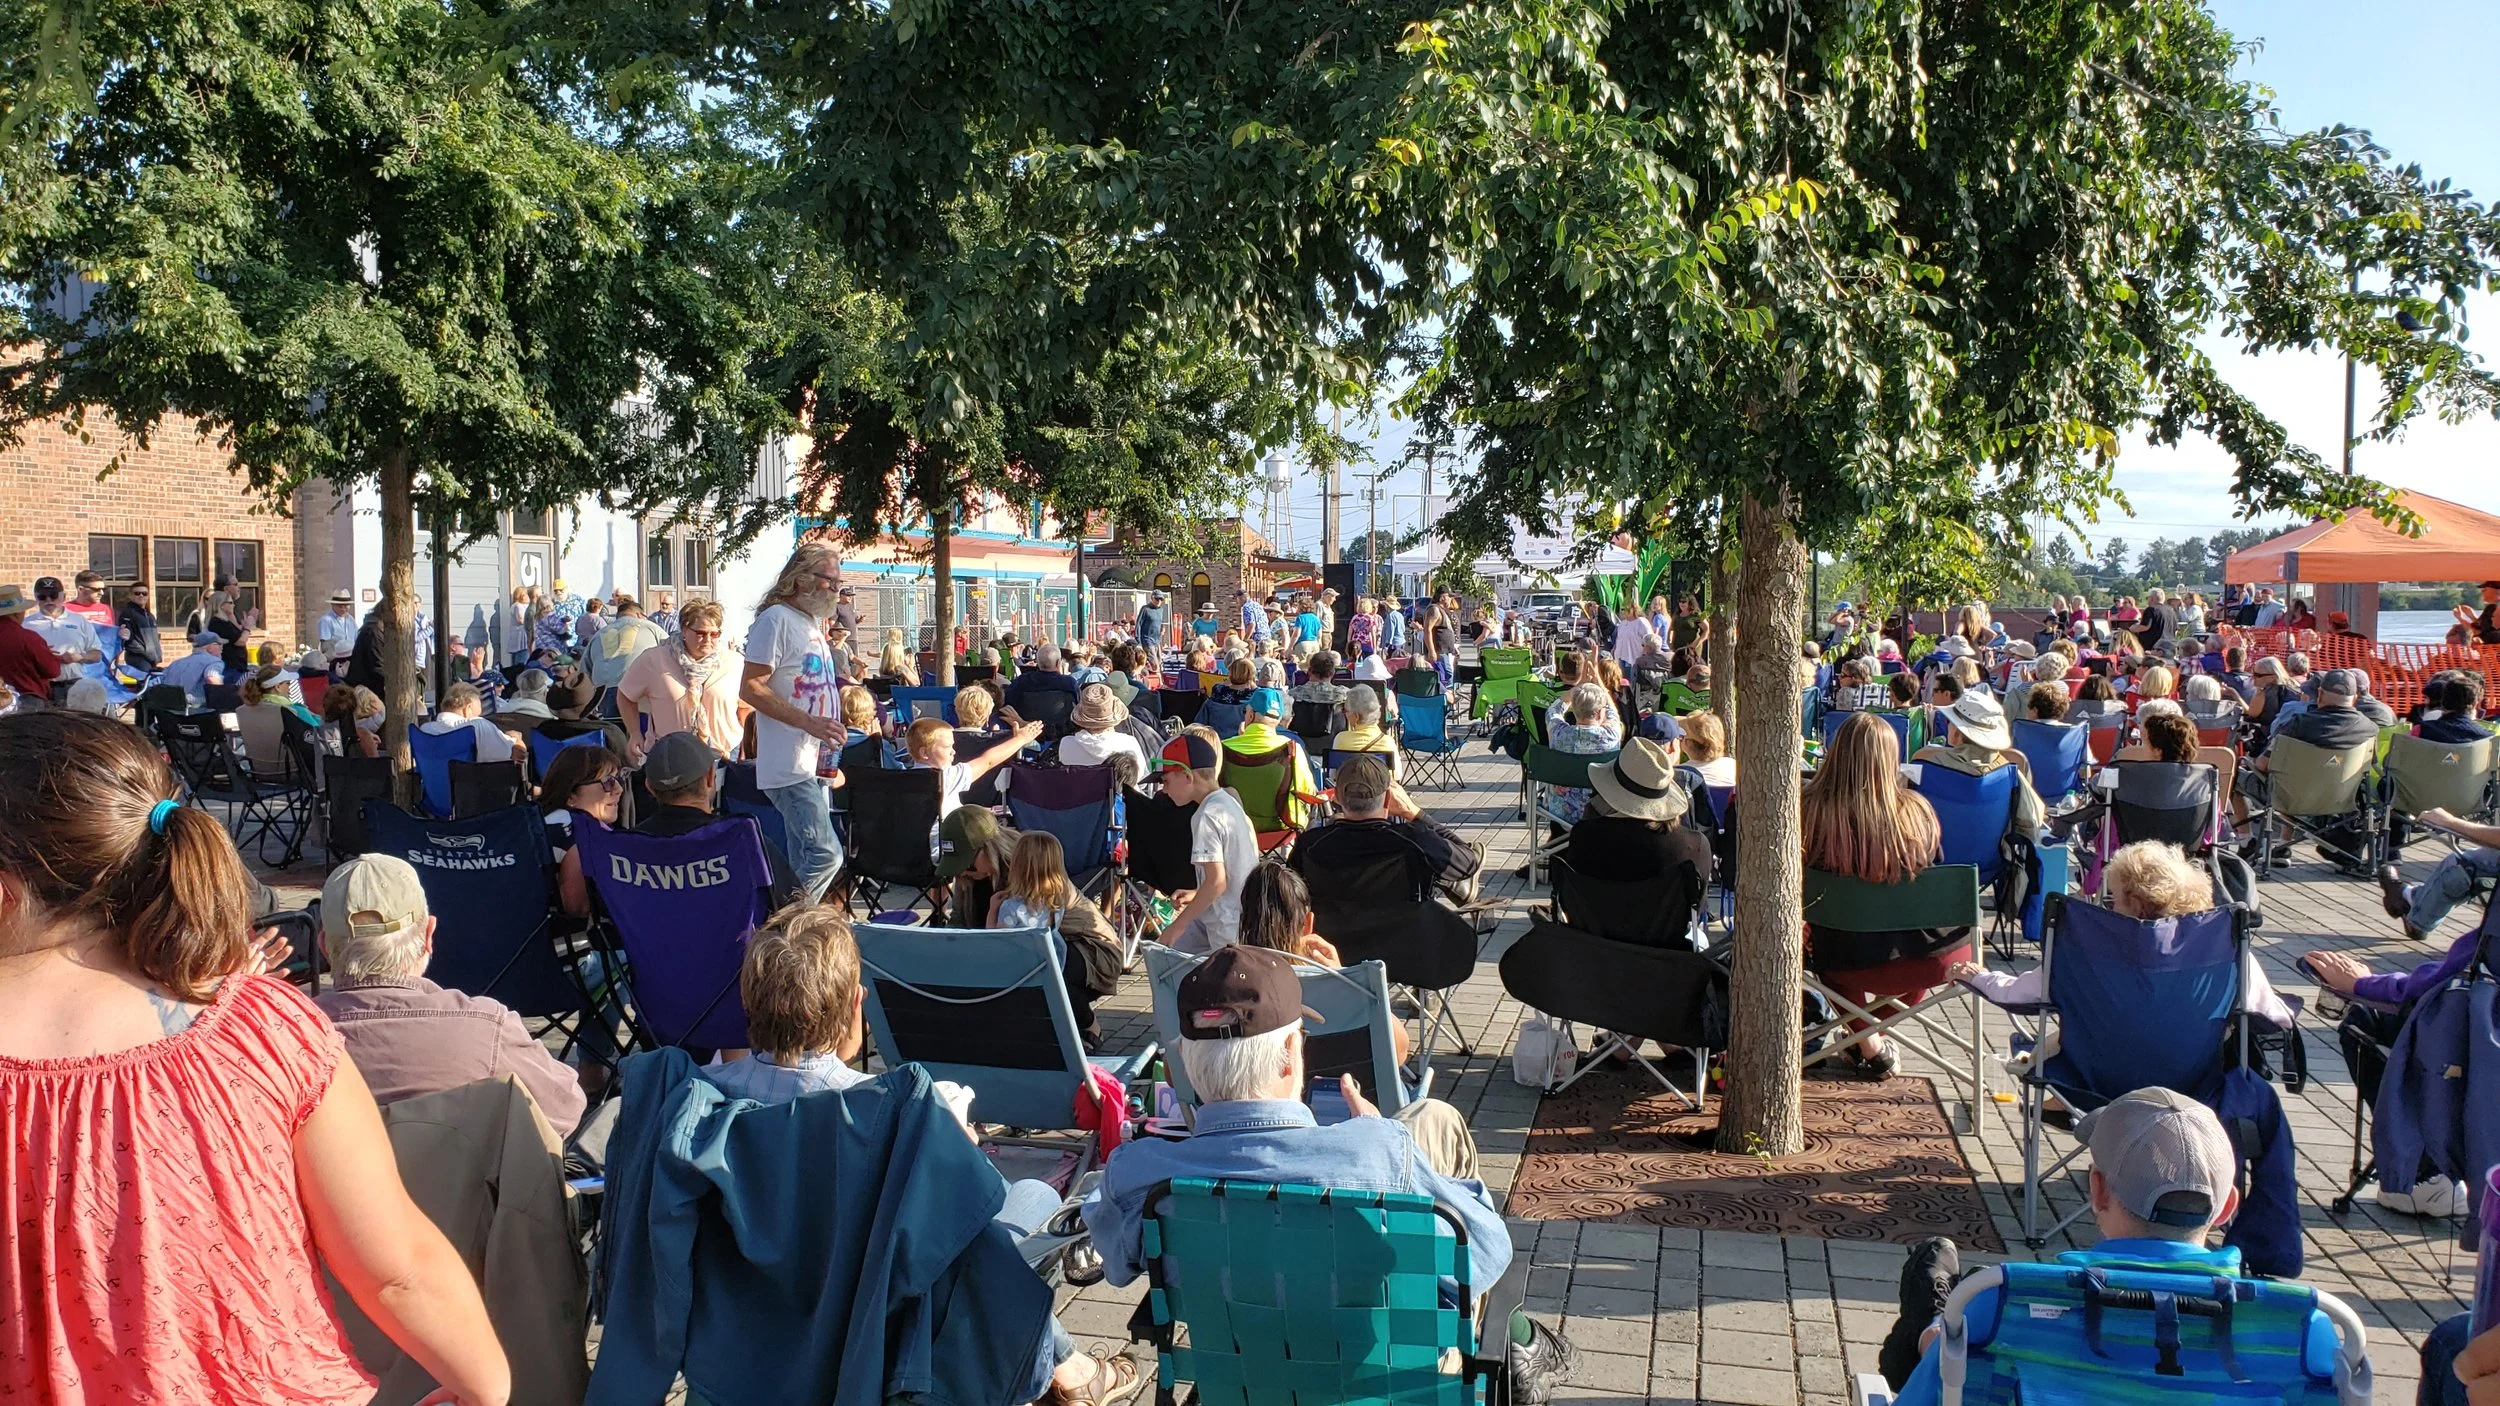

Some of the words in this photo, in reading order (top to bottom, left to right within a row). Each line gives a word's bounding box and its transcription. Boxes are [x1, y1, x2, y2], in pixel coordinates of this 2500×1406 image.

[407, 849, 516, 870] SEAHAWKS
[426, 849, 494, 857] SEATTLE
[609, 853, 730, 890] DAWGS
